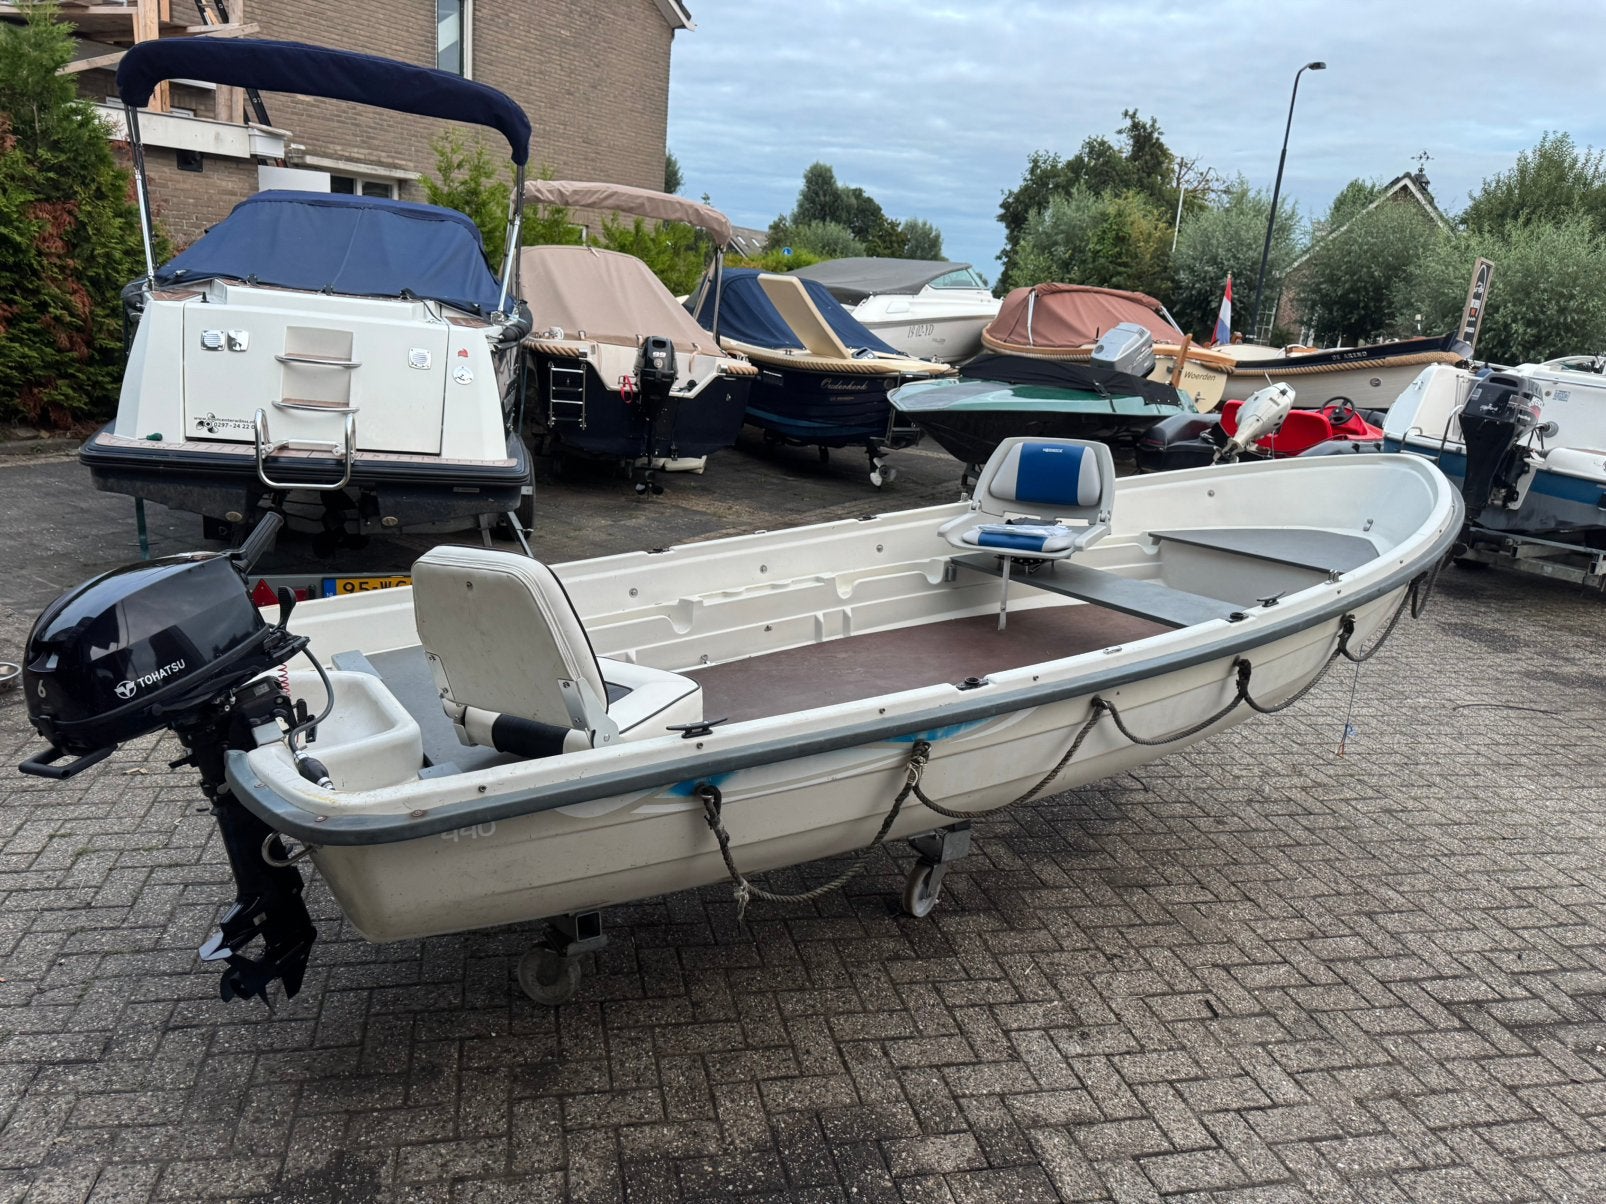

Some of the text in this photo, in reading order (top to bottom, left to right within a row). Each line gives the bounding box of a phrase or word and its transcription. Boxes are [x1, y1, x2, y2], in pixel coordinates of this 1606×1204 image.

[1184, 371, 1216, 381] Woerden
[137, 658, 186, 688] TOHATSU
[37, 679, 47, 698] 6
